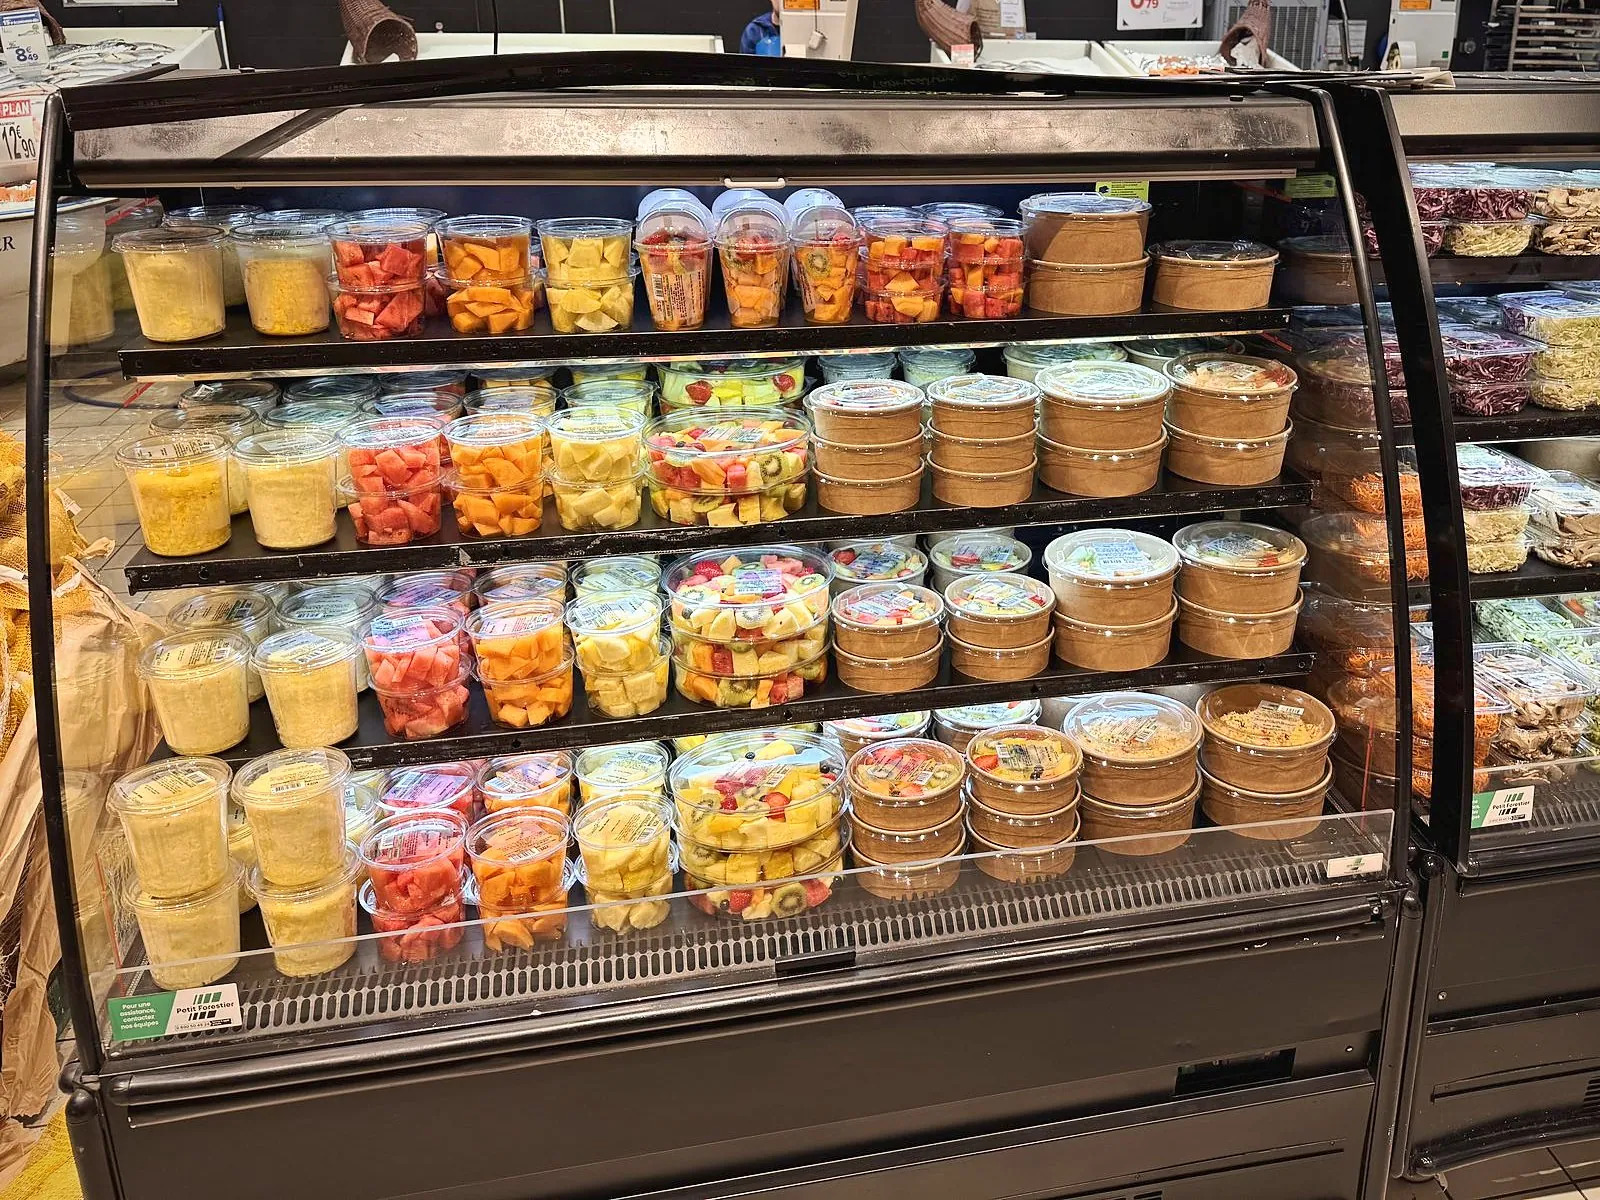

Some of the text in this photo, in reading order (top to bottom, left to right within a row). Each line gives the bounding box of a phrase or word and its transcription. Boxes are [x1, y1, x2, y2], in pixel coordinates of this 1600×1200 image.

[2, 100, 30, 116] PLAN
[0, 236, 16, 251] R
[120, 1008, 156, 1017] assistance,
[176, 1001, 234, 1014] Petit Forestier
[133, 1020, 159, 1029] équipes
